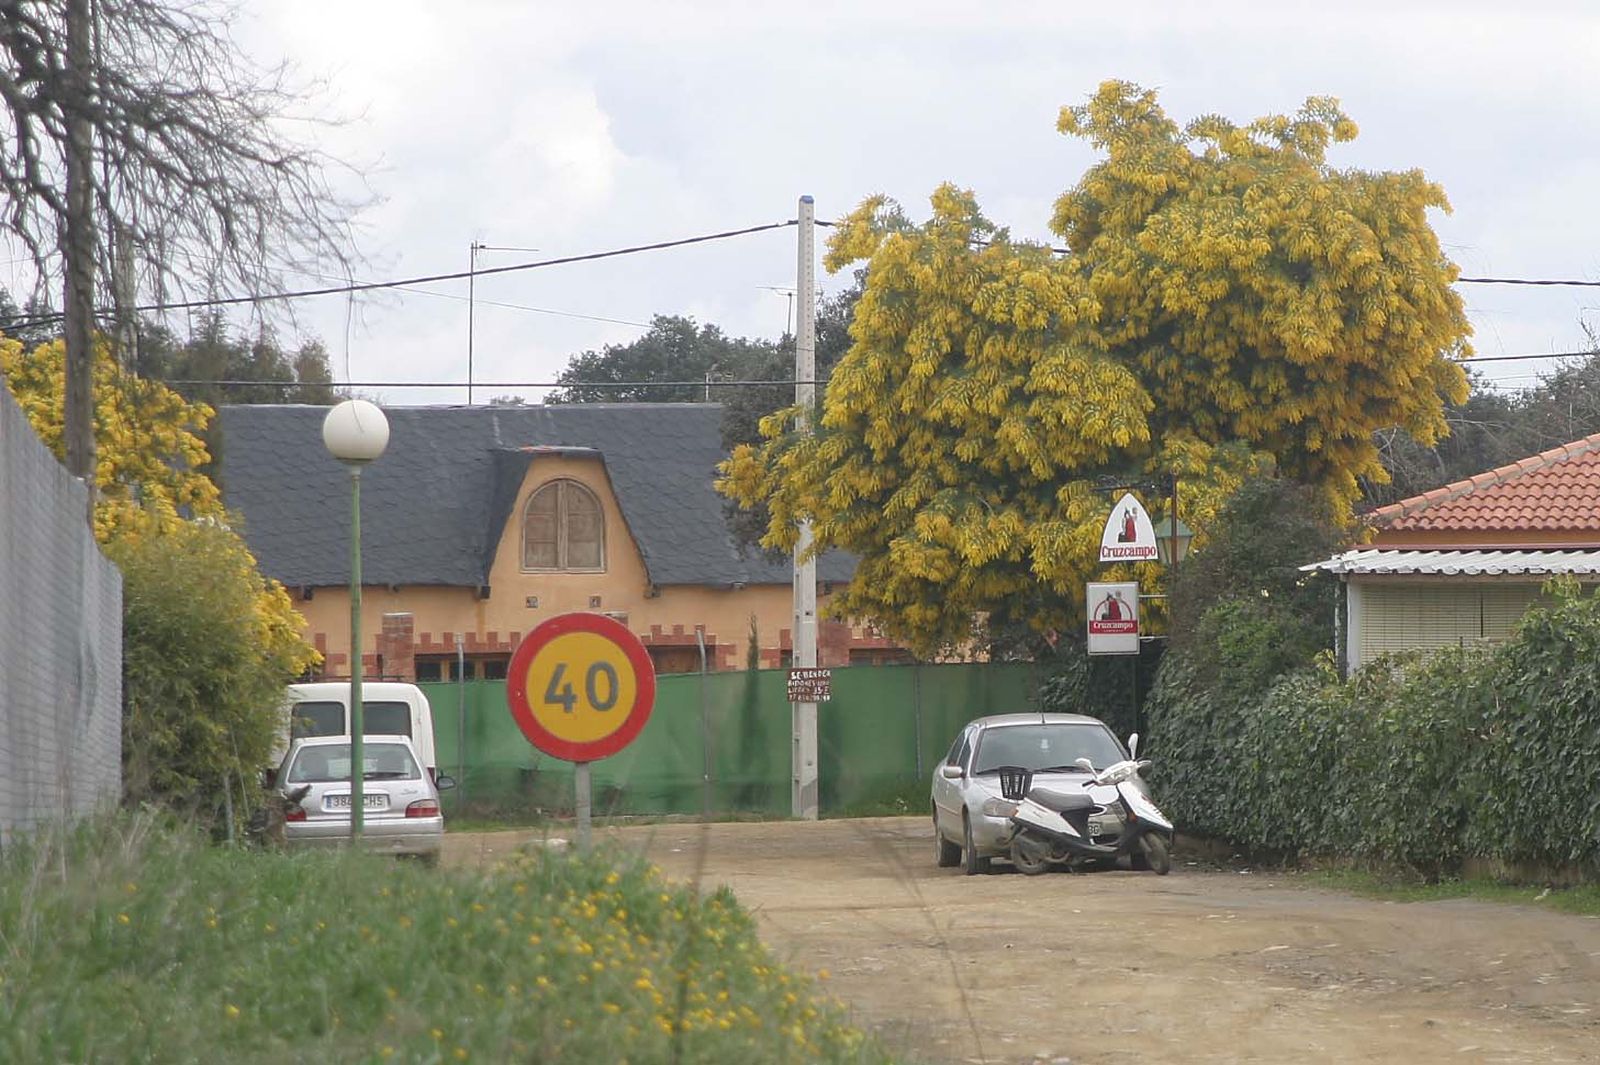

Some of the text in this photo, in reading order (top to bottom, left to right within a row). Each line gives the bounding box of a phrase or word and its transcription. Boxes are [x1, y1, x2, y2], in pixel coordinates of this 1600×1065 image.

[1102, 545, 1156, 559] Cruzcampo
[1093, 622, 1133, 630] Cruzcampo
[544, 661, 619, 713] 40
